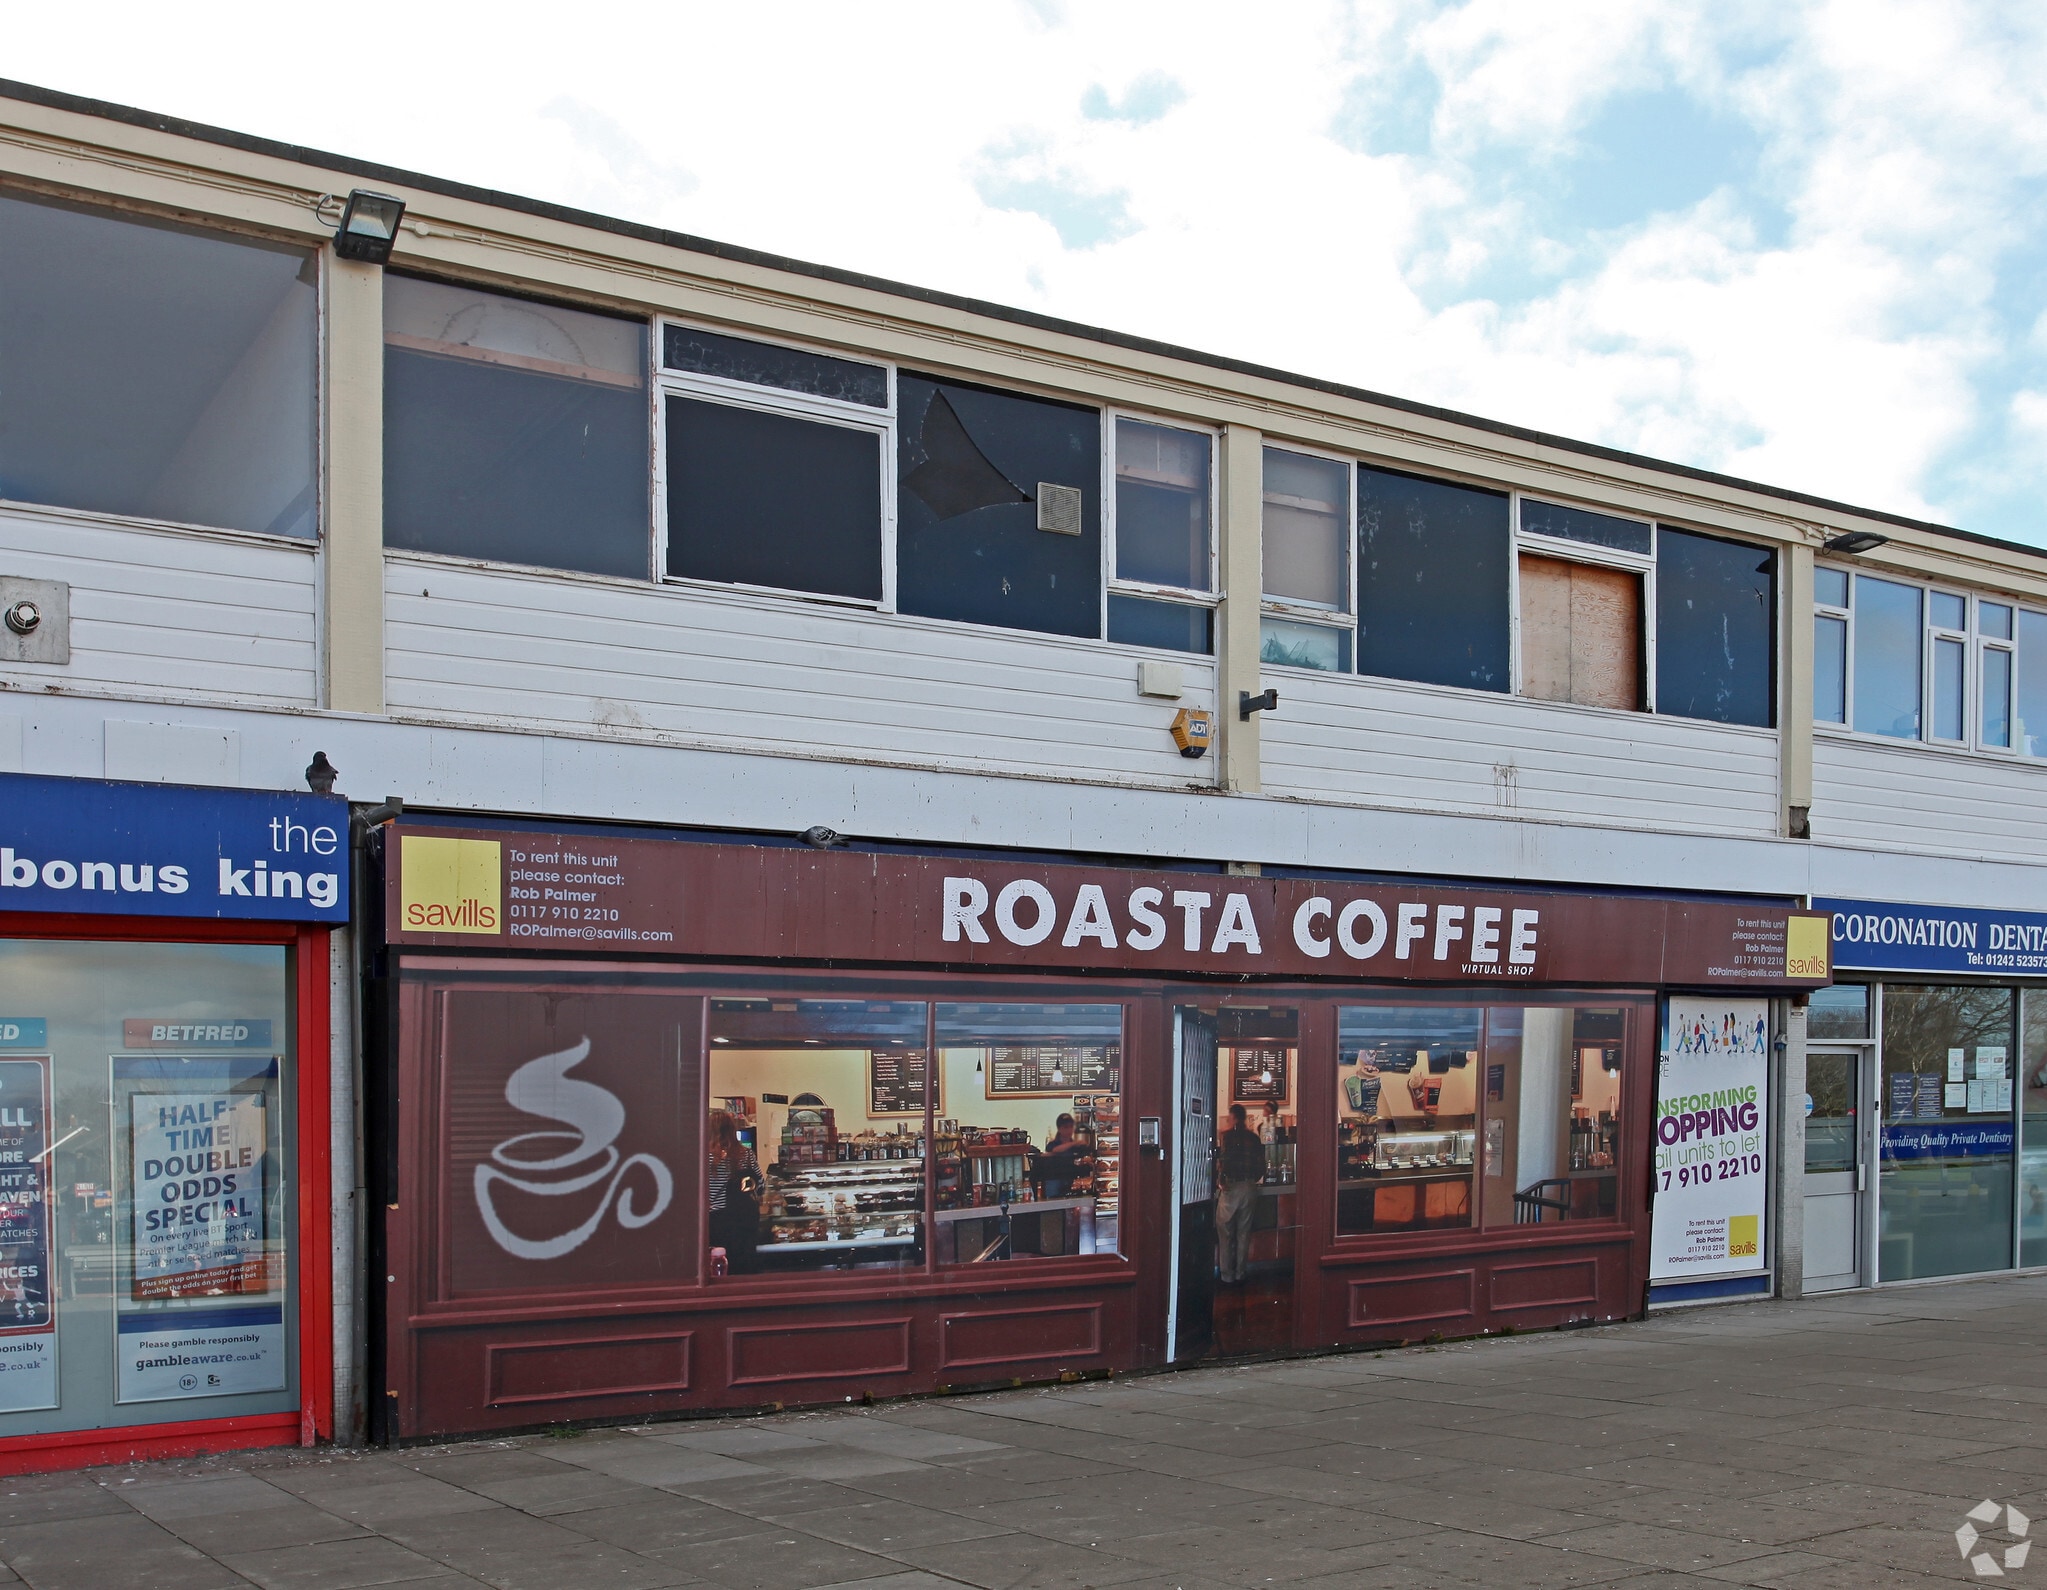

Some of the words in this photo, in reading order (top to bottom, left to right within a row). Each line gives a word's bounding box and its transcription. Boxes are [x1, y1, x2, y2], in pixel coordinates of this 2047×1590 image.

[1189, 724, 1207, 734] ADT
[269, 816, 338, 855] the
[510, 850, 526, 863] To
[530, 851, 559, 865] rent
[563, 853, 588, 866] this
[592, 855, 618, 867] unit
[0, 848, 190, 894] bonus
[219, 858, 338, 908] king
[510, 868, 560, 883] please
[565, 872, 625, 886] contact:
[510, 887, 540, 900] Rob
[544, 888, 597, 903] Palmer
[407, 899, 497, 929] savills
[510, 905, 547, 919] 0117
[552, 906, 579, 920] 910
[583, 908, 619, 922] 2210
[942, 876, 1262, 955] ROASTA
[1293, 896, 1539, 964] COFFEE
[1737, 918, 1745, 928] To
[1746, 919, 1759, 929] rent
[1760, 919, 1772, 929] this
[1773, 921, 1785, 930] unit
[1832, 912, 1978, 950] CORONATION
[510, 924, 673, 942] ROPalmer@savills.com
[1732, 931, 1755, 941] please
[1745, 944, 1759, 953] Rob
[1760, 944, 1784, 954] Palmer
[1734, 955, 1752, 965] 0117
[1753, 956, 1766, 965] 910
[1767, 956, 1784, 966] 2210
[1788, 955, 1825, 975] savills
[1966, 952, 1984, 966] Tel:
[1986, 953, 2015, 967] 01242
[1461, 964, 1503, 975] VIRTUAL
[1507, 965, 1534, 976] SHOP
[1707, 967, 1784, 979] ROPalmer@savills.com
[151, 1025, 249, 1042] BETFRED
[165, 1124, 231, 1151] TIME
[1880, 1134, 1919, 1149] Providing
[1920, 1133, 1950, 1150] Quality
[1951, 1132, 1978, 1146] Private
[1979, 1131, 2013, 1146] Dentistry
[1677, 1141, 1715, 1165] units
[1719, 1138, 1736, 1157] to
[1740, 1131, 1760, 1153] let
[144, 1146, 252, 1181] DOUBLE
[1678, 1163, 1713, 1188] 910
[1717, 1153, 1761, 1181] 2210
[160, 1174, 237, 1204] ODDS
[145, 1197, 253, 1231] SPECIAL
[1696, 1219, 1706, 1227] rent
[150, 1234, 164, 1244] On
[166, 1231, 191, 1241] every
[193, 1228, 209, 1237] live
[225, 1222, 248, 1233] Sport
[1685, 1229, 1703, 1237] please
[1707, 1235, 1725, 1243] Palmer
[139, 1245, 175, 1257] Premier
[177, 1240, 211, 1251] League
[214, 1247, 250, 1259] matches
[1729, 1241, 1757, 1256] savills
[141, 1280, 157, 1288] Plus
[159, 1277, 174, 1286] sign
[175, 1276, 185, 1284] up
[186, 1273, 208, 1281] online
[210, 1268, 230, 1277] today
[142, 1286, 168, 1296] double
[183, 1281, 200, 1289] odds
[139, 1341, 169, 1349] Please
[171, 1337, 206, 1349] gamble
[208, 1334, 260, 1345] responsibly
